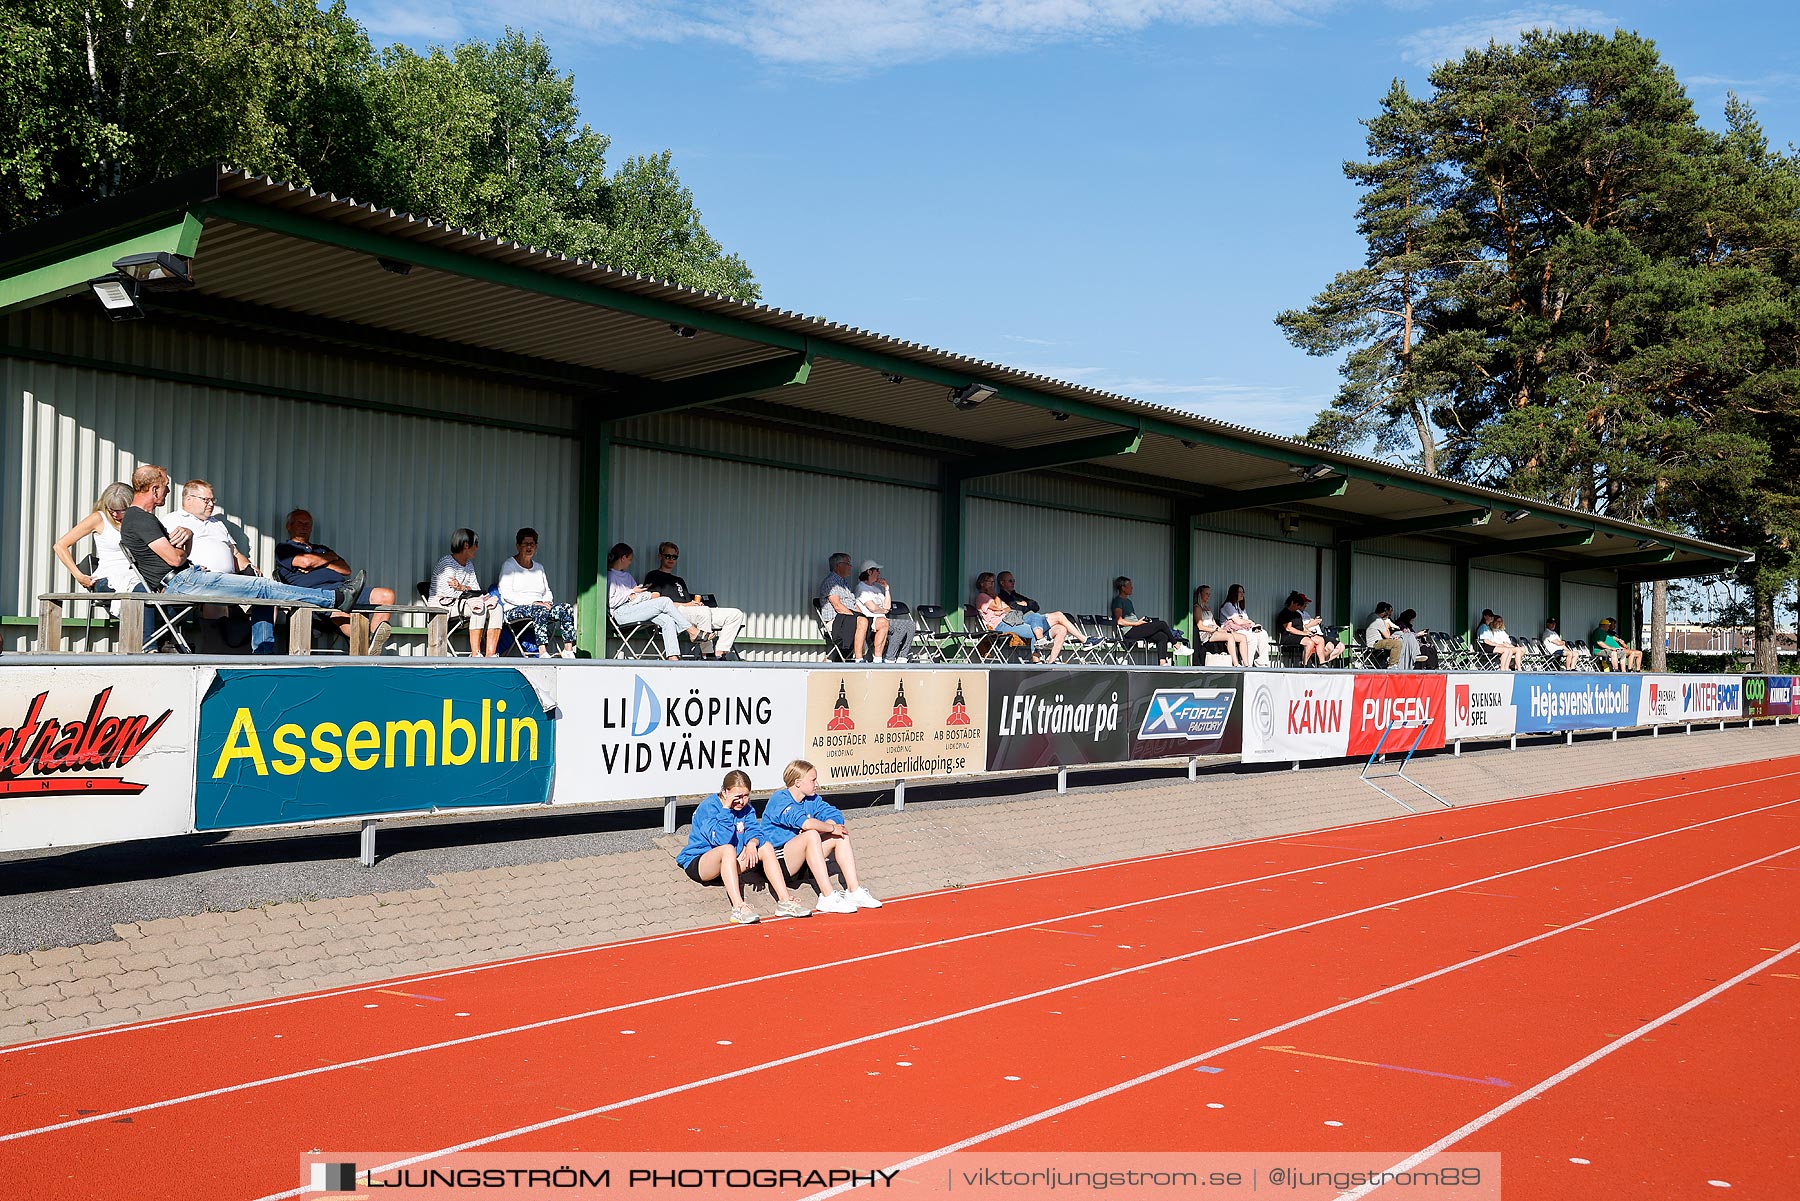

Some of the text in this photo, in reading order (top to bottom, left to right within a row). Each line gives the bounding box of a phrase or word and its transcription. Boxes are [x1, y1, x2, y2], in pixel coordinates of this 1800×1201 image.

[1658, 691, 1676, 701] SVENSKA
[1692, 683, 1739, 712] INTERSPORT
[1746, 679, 1764, 704] coop
[603, 674, 772, 736] LIDKÖPING
[1471, 693, 1501, 708] SVENSKA
[1530, 683, 1629, 723] Heja svensk fotboll!
[999, 692, 1118, 741] LFK tränar på
[1147, 696, 1225, 731] X-FORCE
[1288, 689, 1342, 734] KÄNN
[1658, 704, 1667, 715] SPEL
[1188, 721, 1222, 731] FACTORY
[1471, 711, 1487, 726] SPEL
[212, 698, 538, 779] Assemblin
[812, 733, 867, 747] AB BOSTÄDER
[874, 730, 925, 743] AB BOSTÄDER
[934, 727, 981, 740] AB BOSTÄDER
[602, 732, 770, 774] VID VÄNERN
[826, 749, 854, 757] LIDKÖPING
[886, 745, 912, 754] LIDKÖPING
[945, 742, 970, 750] LIDKÖPING
[830, 755, 966, 779] www.bostaderlidkoping.se
